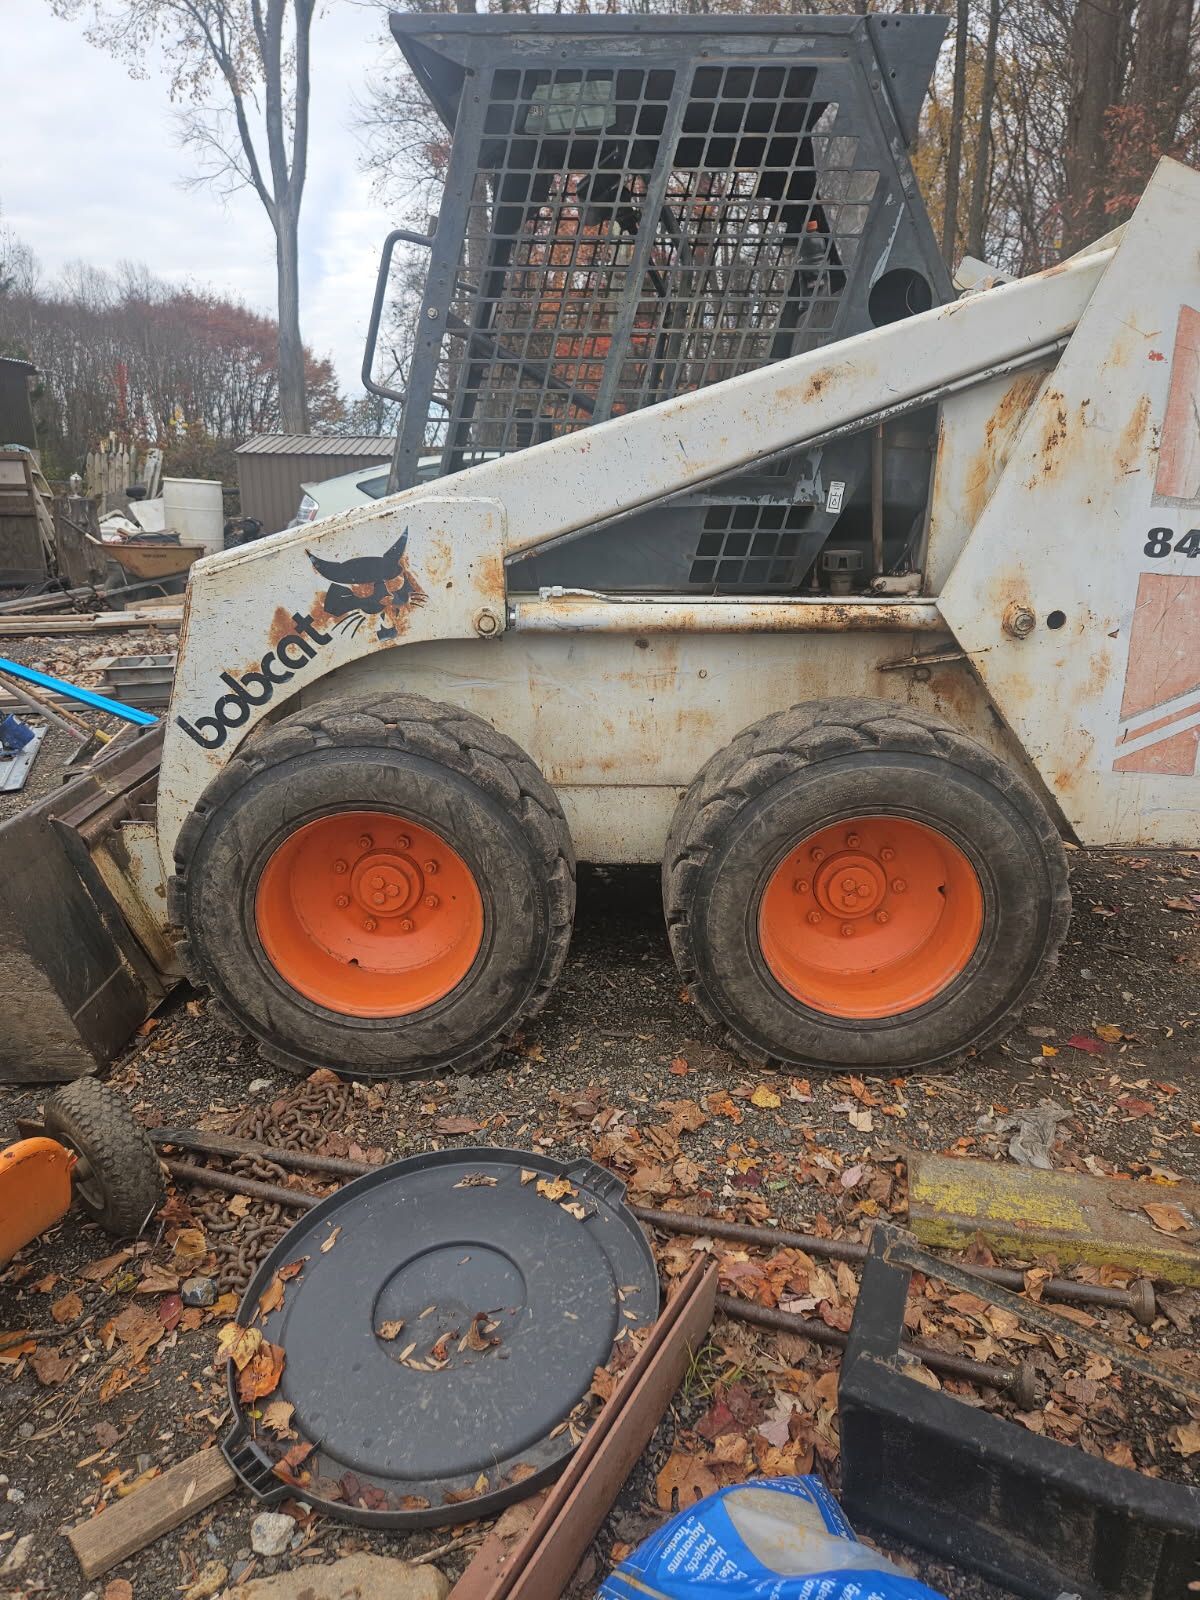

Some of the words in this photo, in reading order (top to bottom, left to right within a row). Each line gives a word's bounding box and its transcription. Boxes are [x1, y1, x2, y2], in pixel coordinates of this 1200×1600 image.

[174, 612, 333, 750] bobcat
[686, 1515, 696, 1526] or
[660, 1525, 690, 1560] Traction
[667, 1521, 706, 1574] Aquariums
[683, 1533, 717, 1573] Projects,
[719, 1559, 738, 1578] Use
